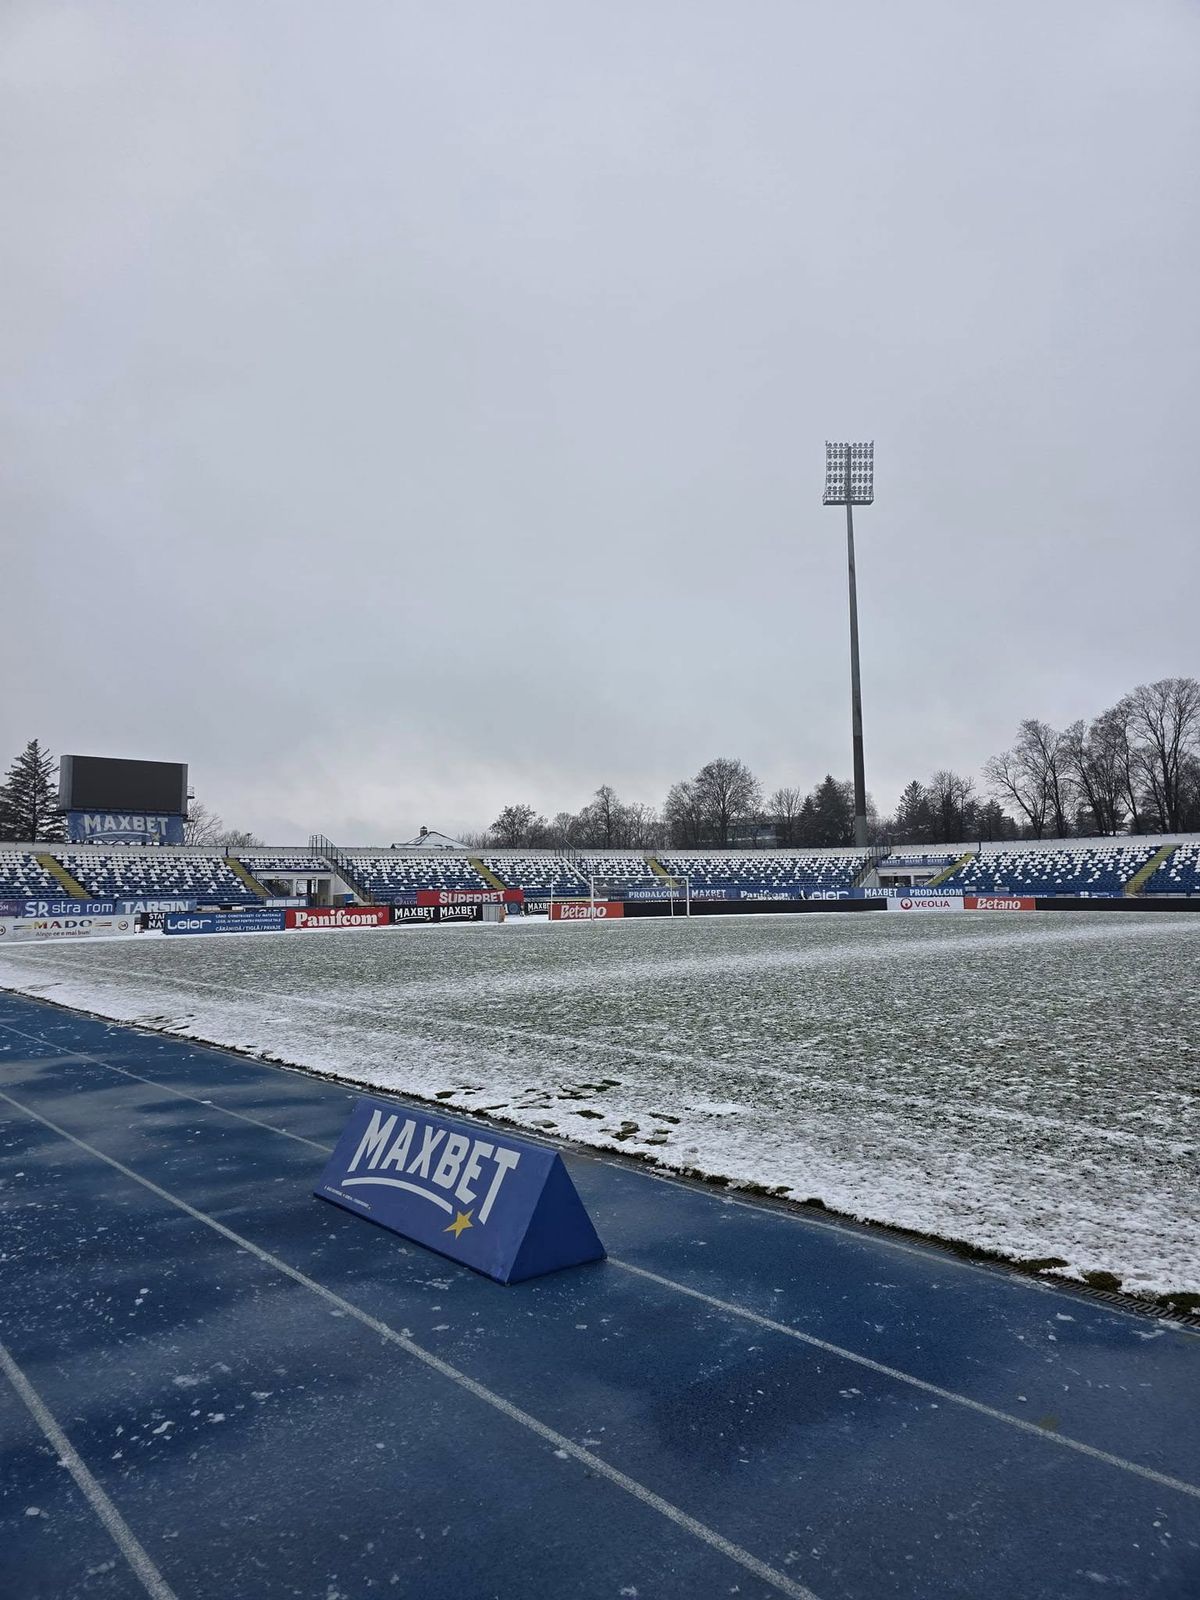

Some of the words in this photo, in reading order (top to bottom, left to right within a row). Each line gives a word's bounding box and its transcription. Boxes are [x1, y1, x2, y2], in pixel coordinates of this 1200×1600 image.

[83, 814, 169, 836] MAXBET
[628, 890, 680, 898] PRODALCOM
[691, 889, 726, 898] MAXBET
[865, 888, 898, 898] MAXBET
[910, 888, 963, 896] PRODALCOM
[24, 901, 50, 917] SR
[52, 900, 81, 914] stra
[86, 902, 113, 913] rom
[122, 901, 189, 914] TARSIN
[914, 900, 950, 908] VEOLIA
[977, 898, 1021, 909] Betano
[394, 906, 435, 919] MAXBET
[440, 905, 478, 918] MAXBET
[560, 905, 607, 919] Betano
[33, 919, 93, 929] MADO
[167, 918, 212, 930] Leier
[347, 1109, 521, 1225] MAXBET
